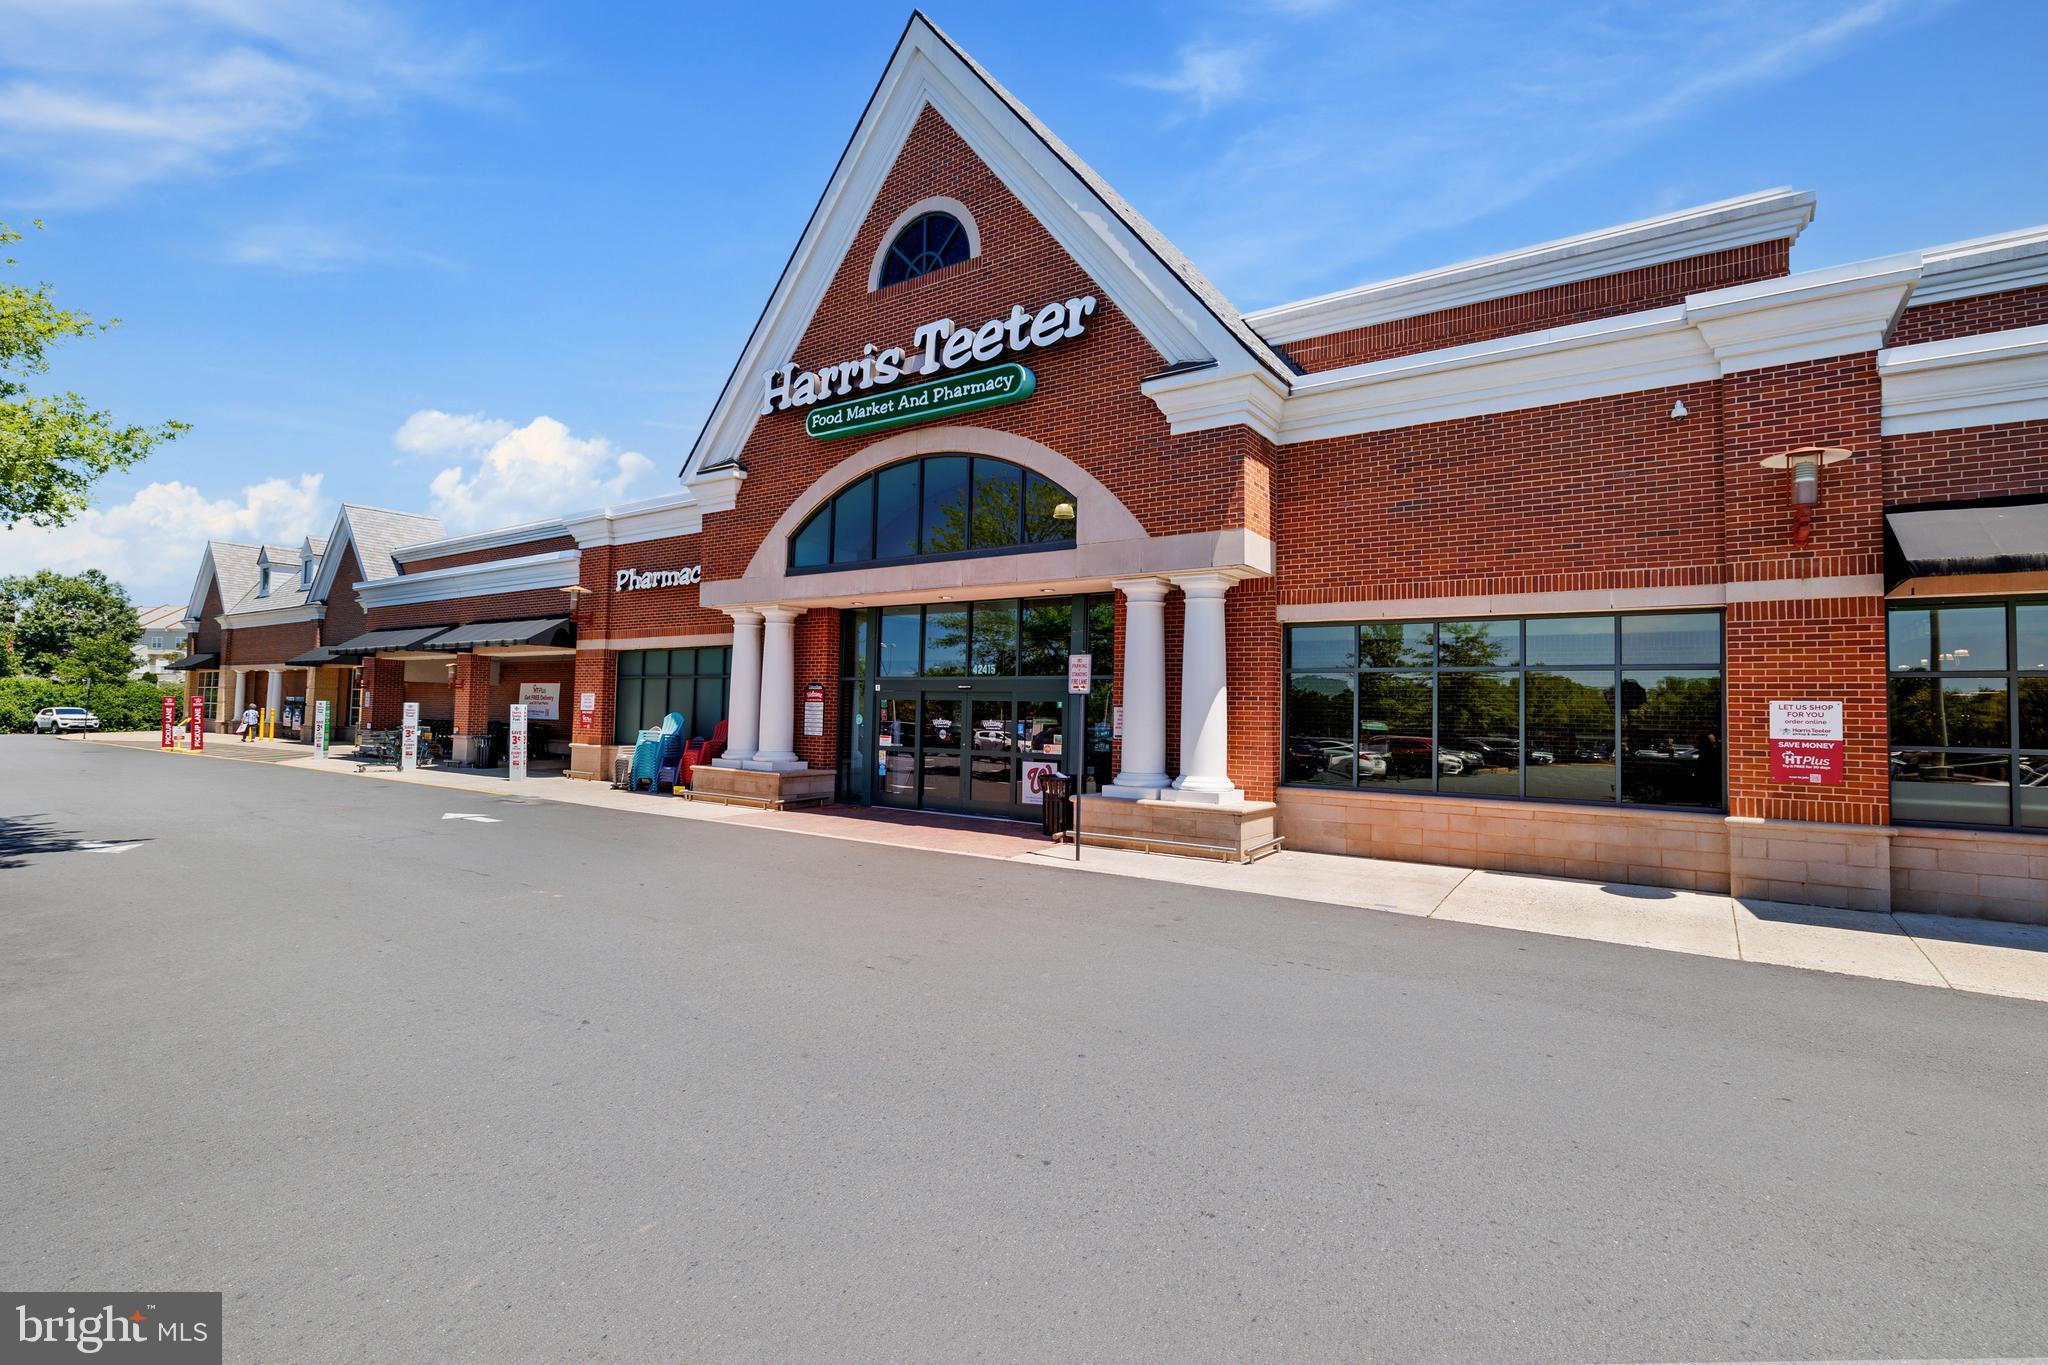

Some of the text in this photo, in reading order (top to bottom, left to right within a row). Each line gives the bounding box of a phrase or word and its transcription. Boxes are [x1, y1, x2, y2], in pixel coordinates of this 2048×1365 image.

[761, 295, 1097, 415] Harris Teeter
[811, 374, 1014, 429] Food Market And Pharmacy
[616, 565, 701, 592] Pharmac
[972, 664, 996, 675] 42415
[165, 707, 173, 723] LANE
[164, 723, 172, 745] PICKUP
[1778, 741, 1800, 749] SAVE
